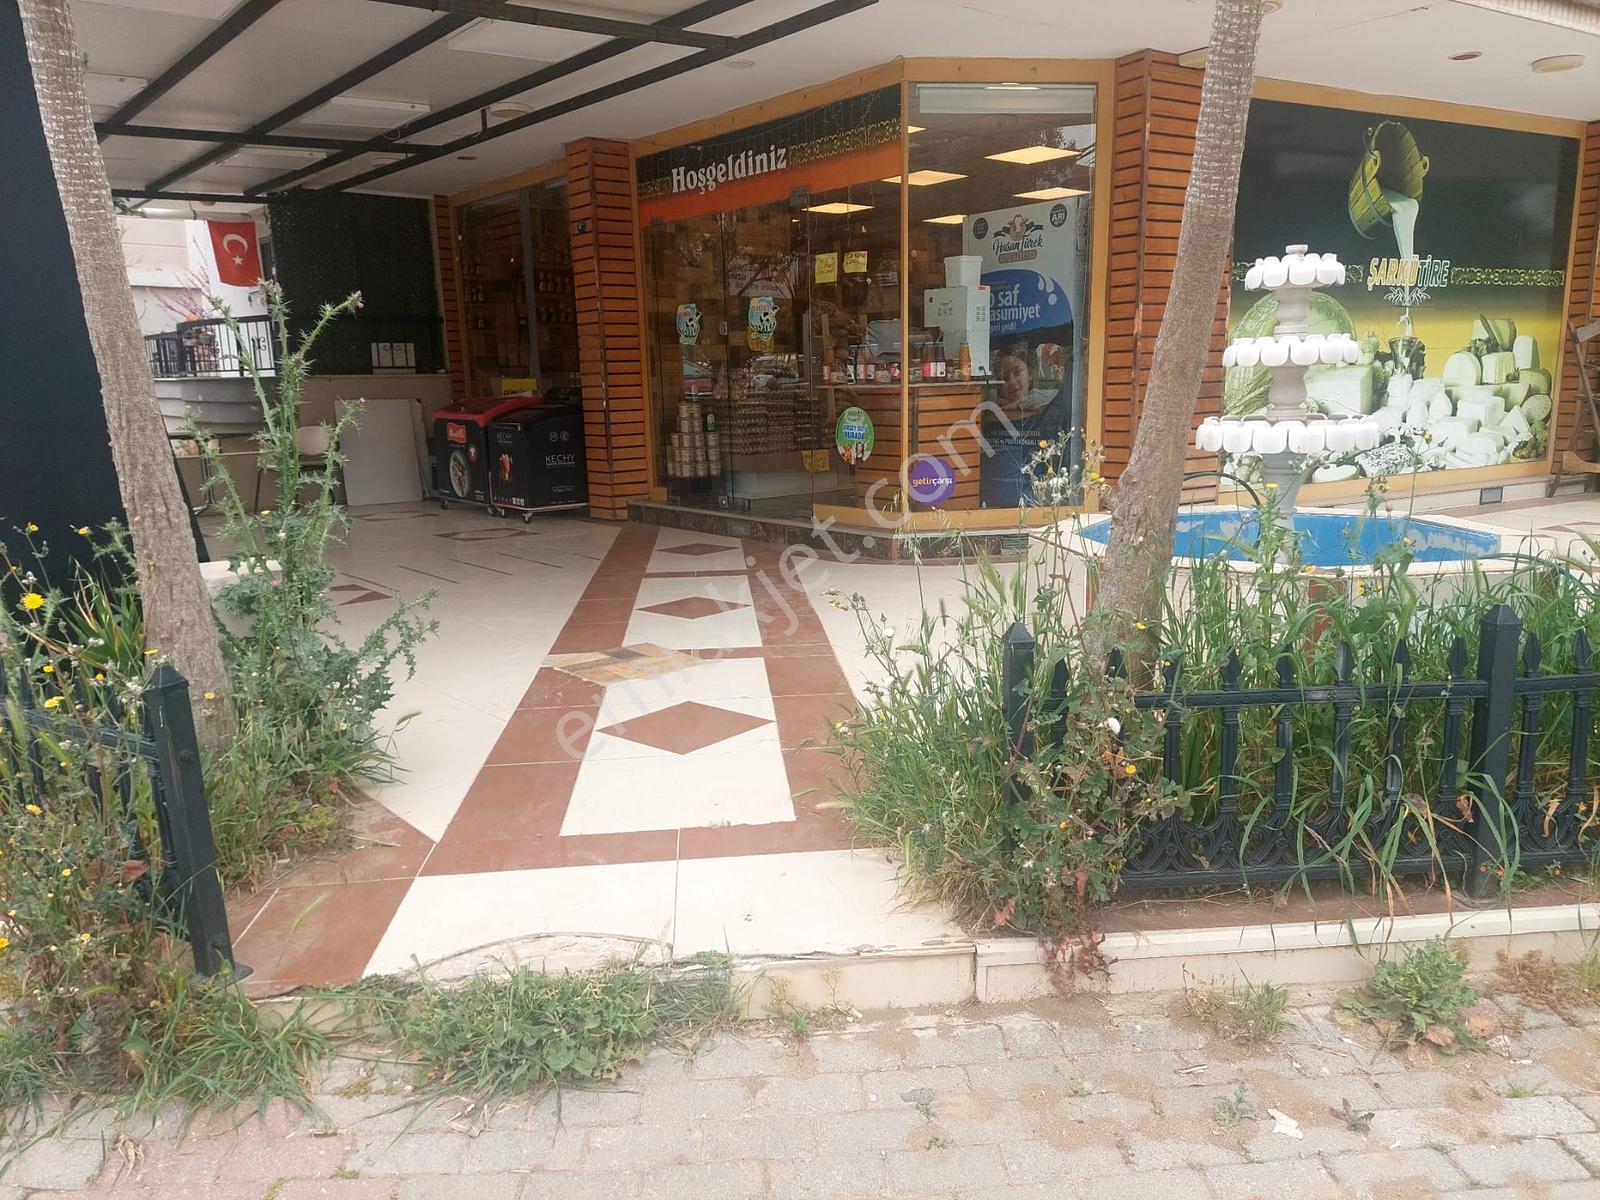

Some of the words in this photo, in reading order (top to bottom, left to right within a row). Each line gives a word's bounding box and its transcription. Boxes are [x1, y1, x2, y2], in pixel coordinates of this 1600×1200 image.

[671, 144, 787, 195] Hoşgeldiniz
[997, 283, 1020, 307] saf
[990, 302, 1041, 323] asumiyet
[844, 431, 865, 440] BURADA
[545, 454, 576, 464] KECHY
[912, 476, 953, 487] getirçarşı
